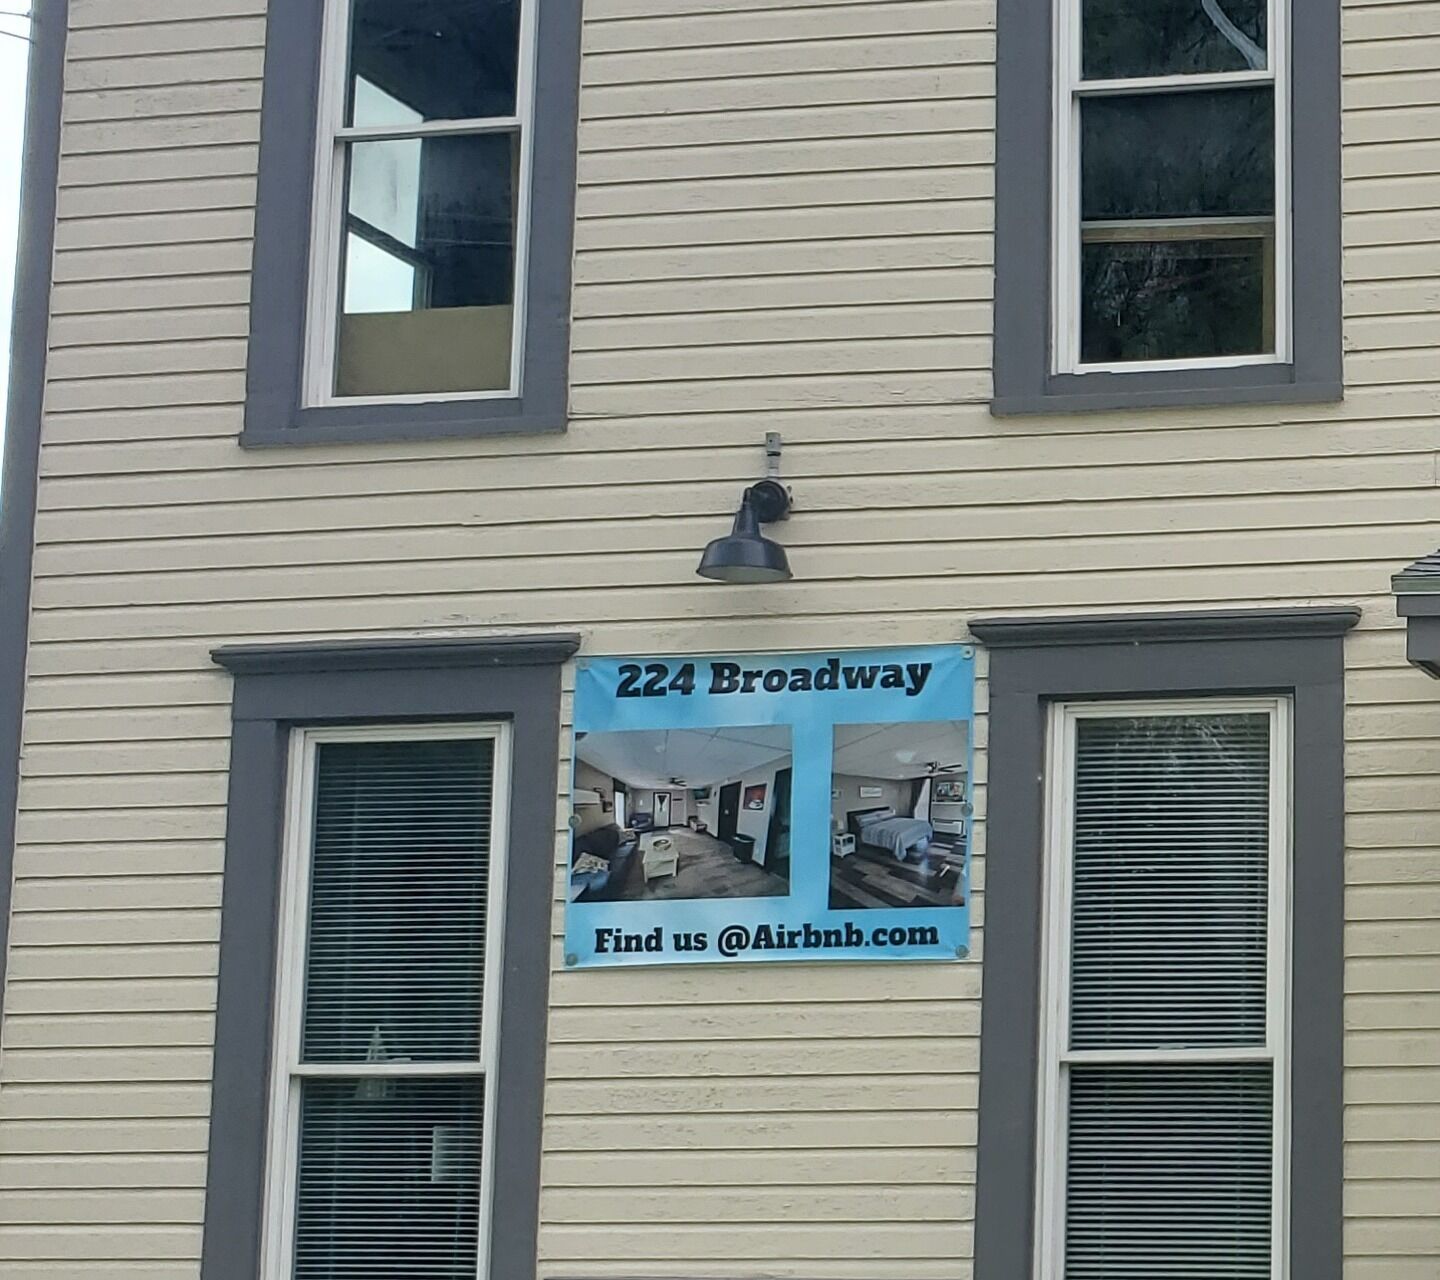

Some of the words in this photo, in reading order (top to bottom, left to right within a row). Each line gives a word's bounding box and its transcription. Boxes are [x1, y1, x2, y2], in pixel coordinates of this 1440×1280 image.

[615, 664, 696, 697] 224
[708, 658, 933, 697] Broadway
[594, 927, 663, 953] Find
[673, 931, 708, 952] us
[718, 922, 939, 957] @Airbnb.com
